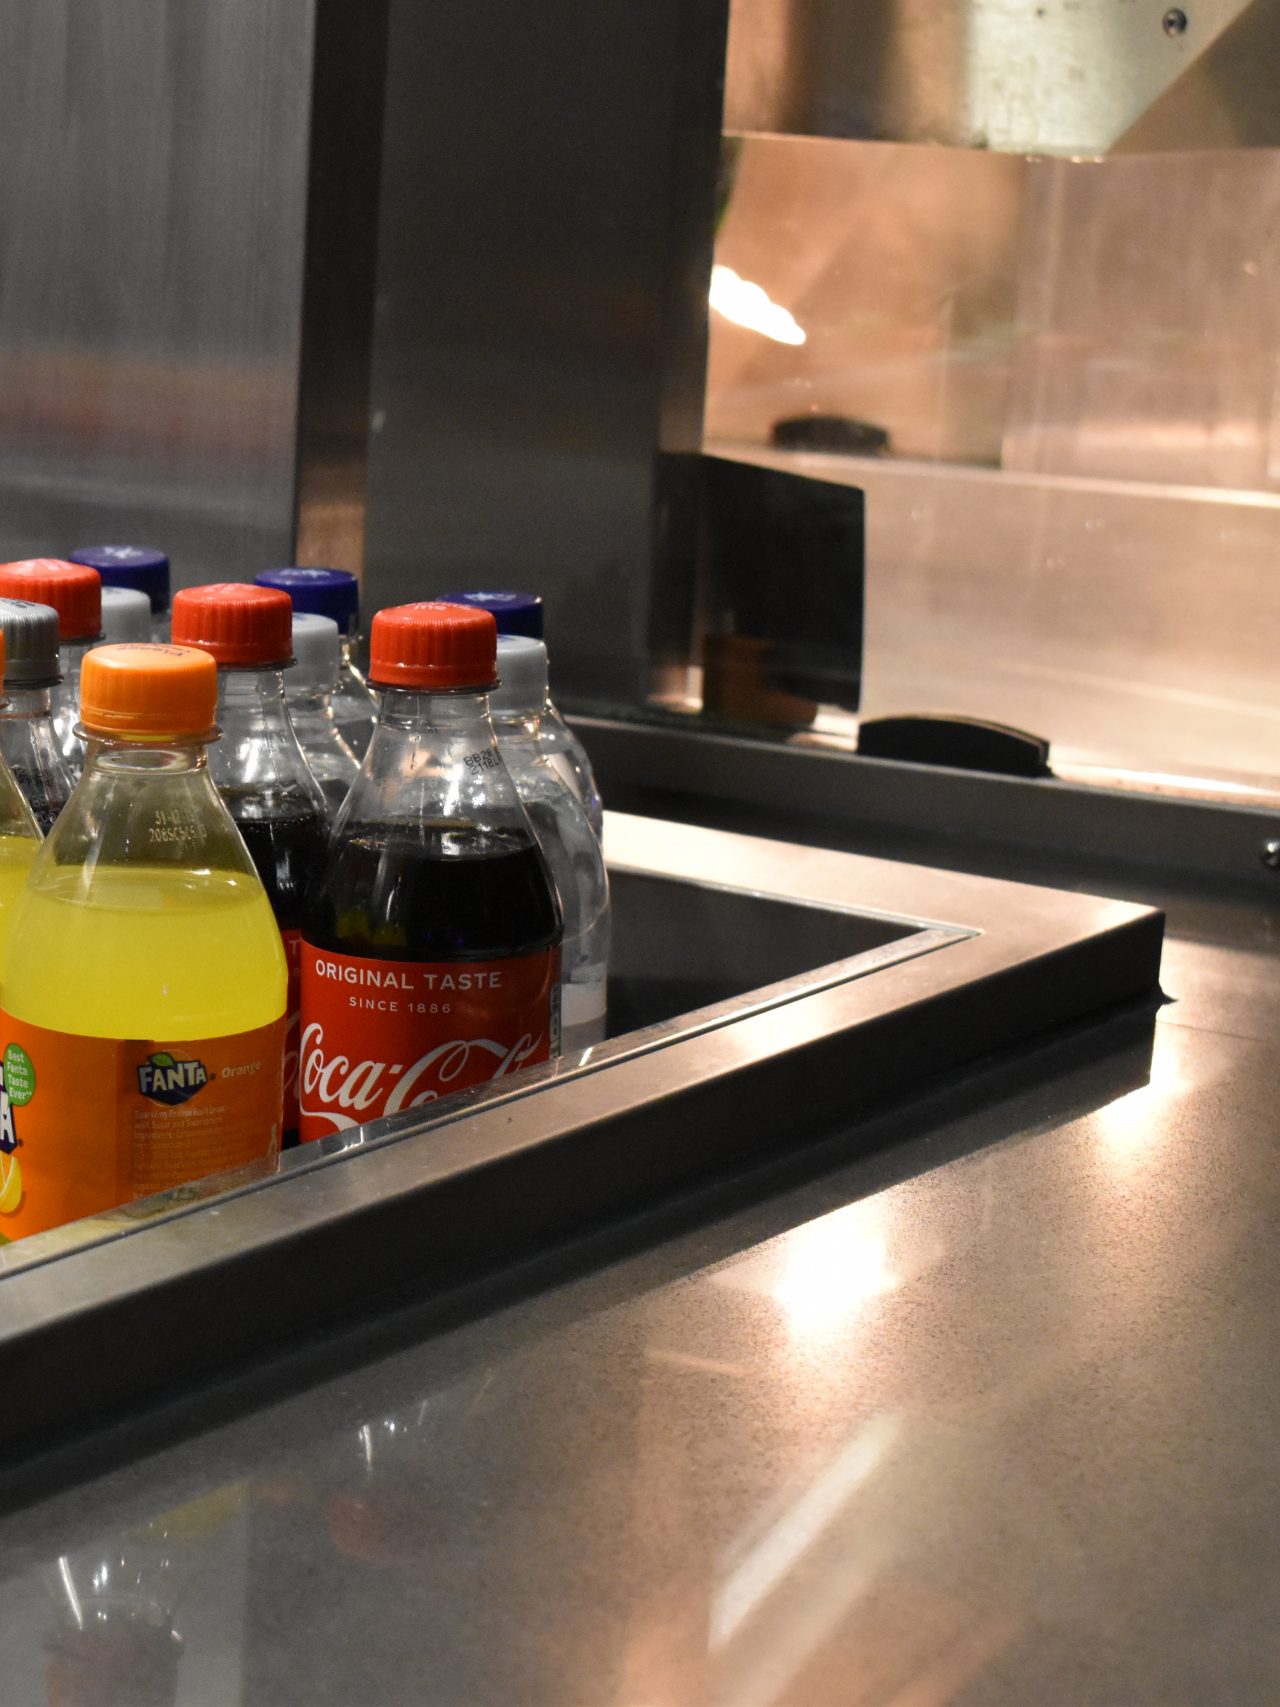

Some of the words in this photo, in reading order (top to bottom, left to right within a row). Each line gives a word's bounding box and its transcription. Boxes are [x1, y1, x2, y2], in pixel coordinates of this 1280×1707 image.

[315, 959, 414, 989] ORIGINAL
[423, 971, 502, 990] TASTE
[349, 996, 399, 1012] SINCE
[408, 1003, 451, 1013] 1886
[7, 1049, 25, 1063] Best
[7, 1062, 28, 1076] Fanta
[139, 1061, 207, 1093] FANTA
[222, 1061, 262, 1079] Orange
[299, 1022, 544, 1117] Coca-C
[7, 1074, 29, 1088] Taste
